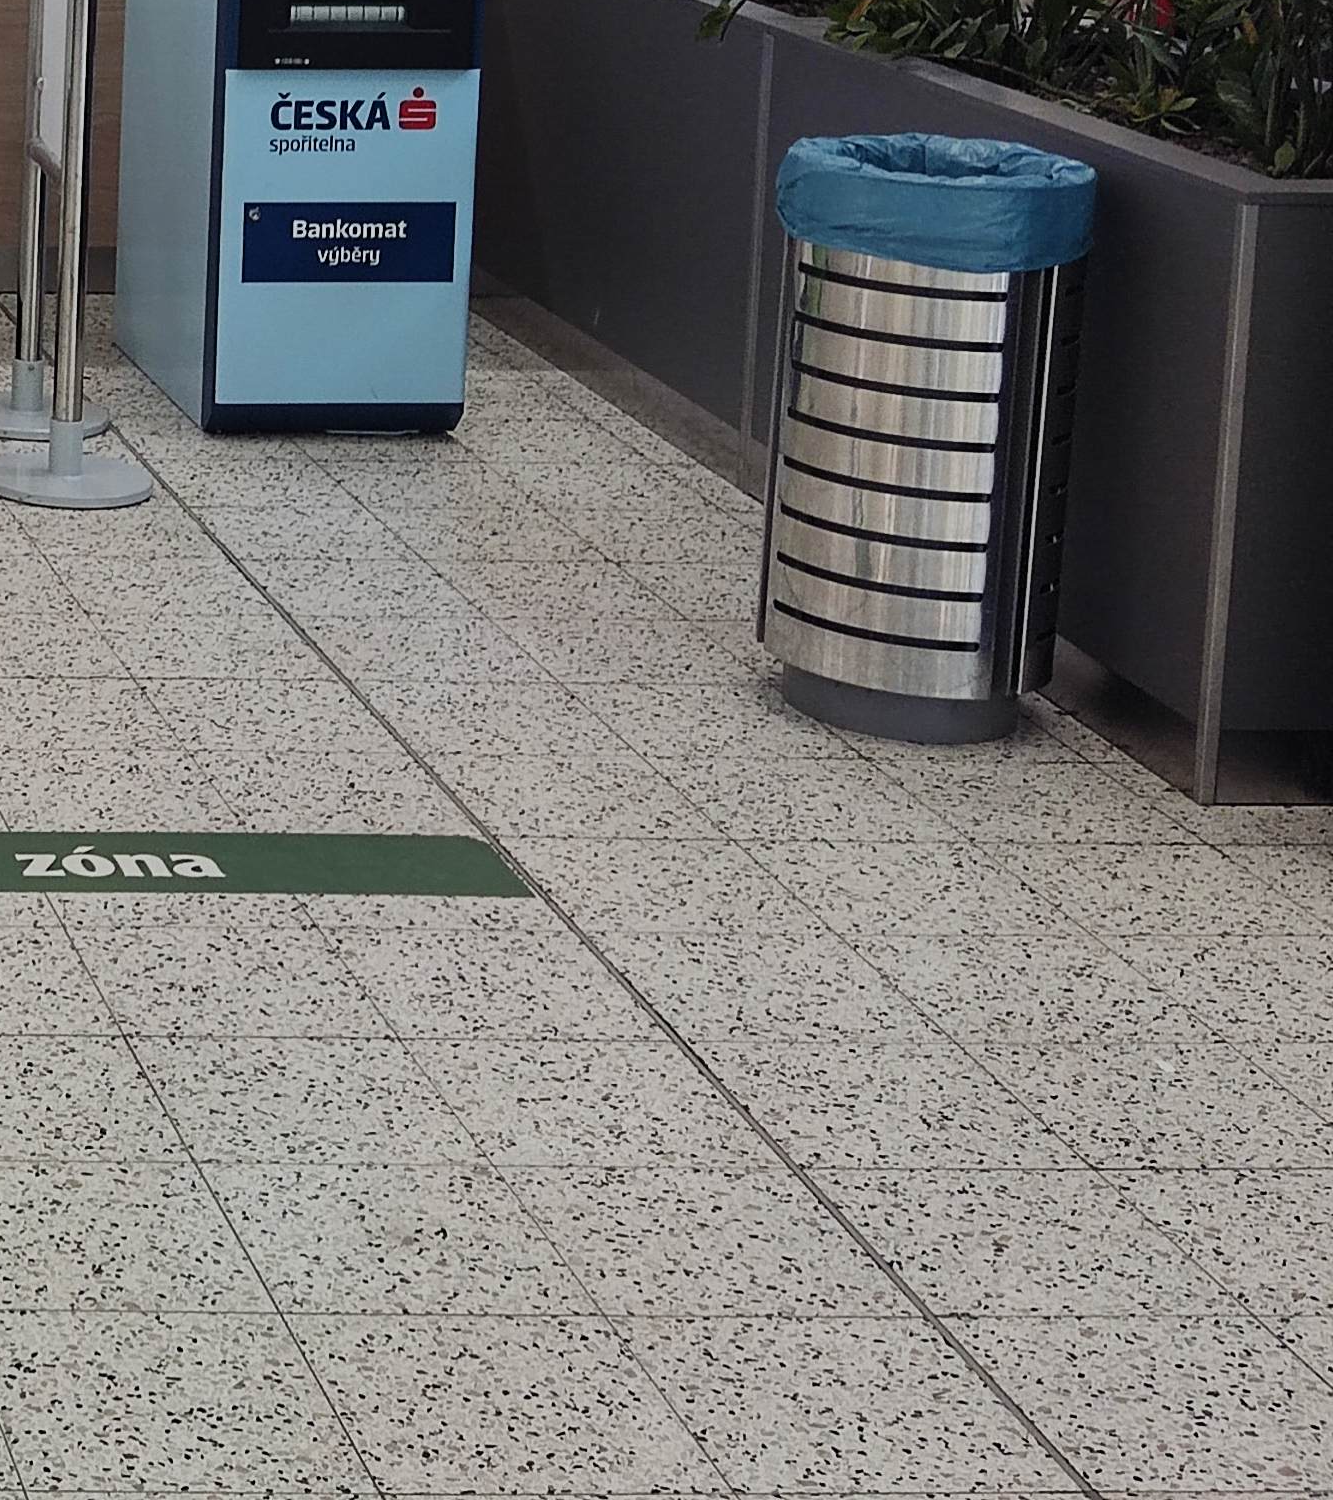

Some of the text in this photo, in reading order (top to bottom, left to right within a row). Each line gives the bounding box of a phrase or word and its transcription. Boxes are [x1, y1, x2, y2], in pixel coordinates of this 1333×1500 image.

[270, 91, 391, 131] ČESKÁ
[269, 134, 356, 156] spořitelna
[292, 218, 407, 240] Bankomat
[317, 244, 381, 267] výběry
[14, 843, 228, 880] zóna
